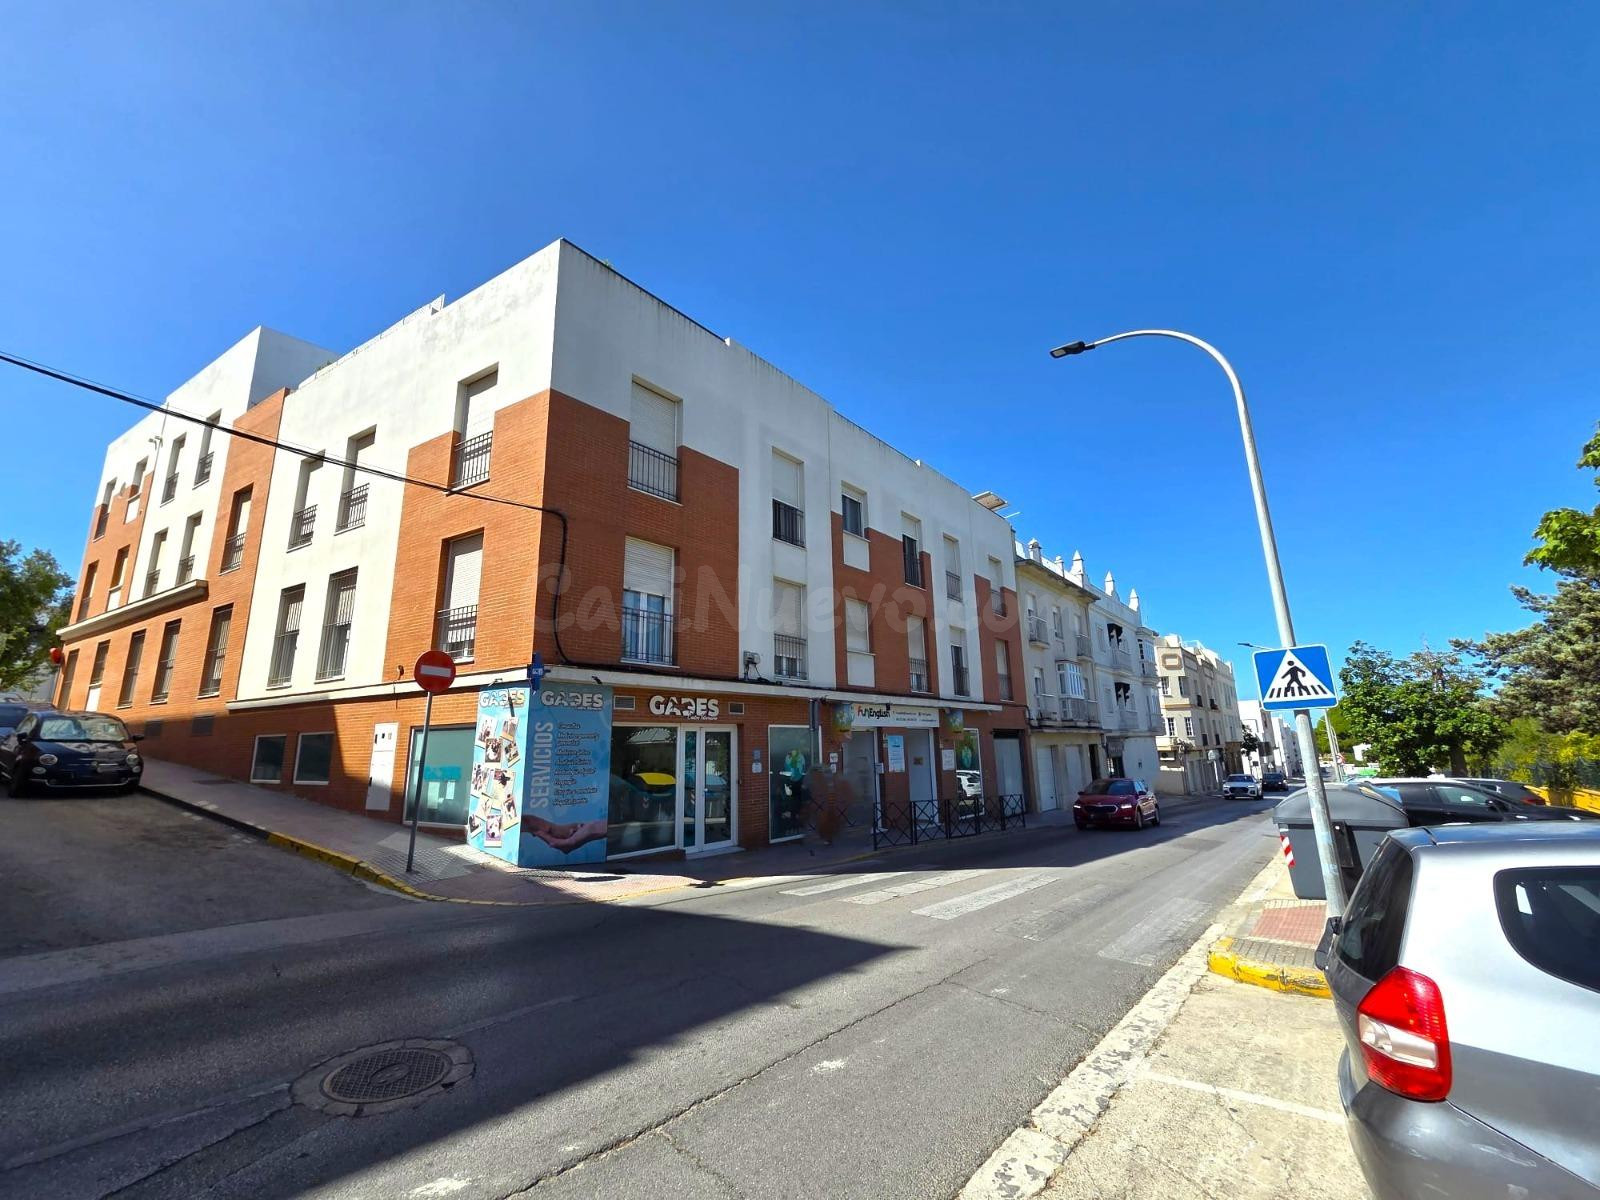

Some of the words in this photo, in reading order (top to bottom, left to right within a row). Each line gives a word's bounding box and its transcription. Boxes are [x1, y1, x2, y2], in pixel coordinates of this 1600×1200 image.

[541, 691, 603, 707] GADES
[649, 695, 720, 716] GADES
[529, 722, 553, 808] SERVICIOS
